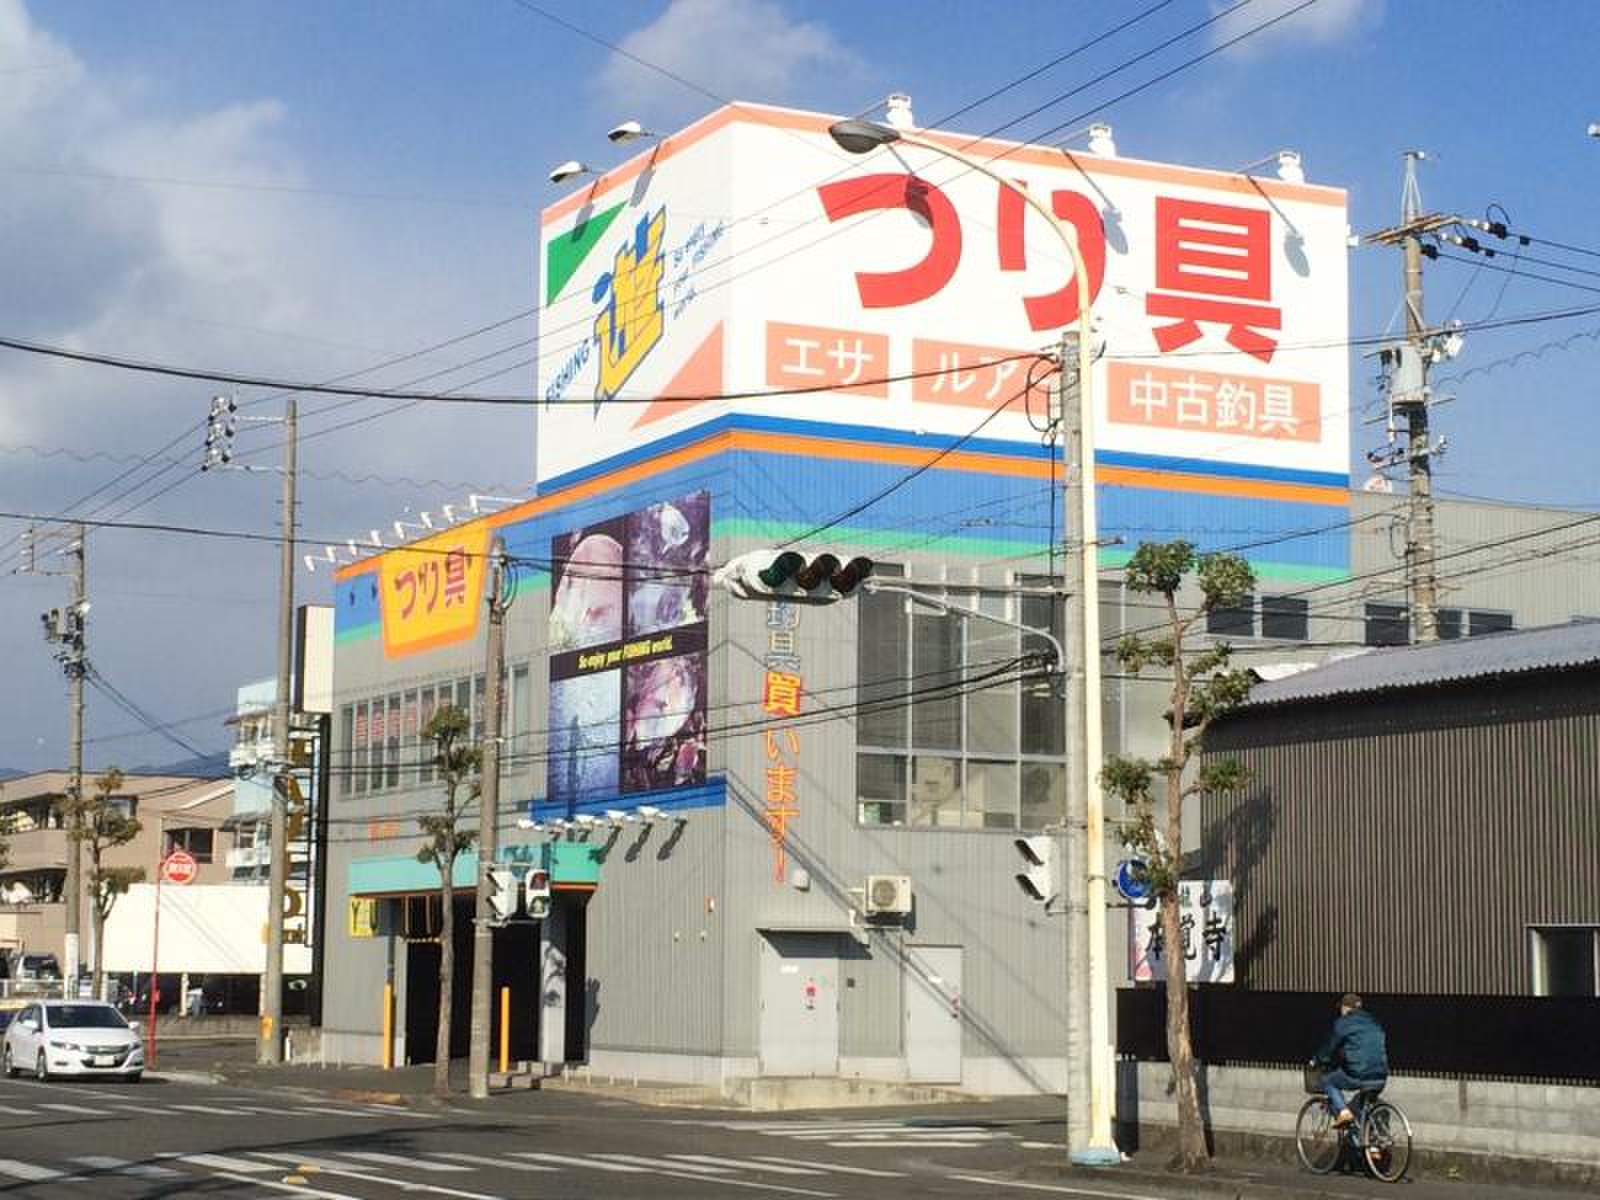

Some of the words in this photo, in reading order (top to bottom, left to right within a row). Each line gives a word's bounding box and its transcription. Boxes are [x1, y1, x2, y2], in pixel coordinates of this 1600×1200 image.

[817, 172, 1283, 363] つり具
[781, 336, 875, 386] エサ
[1129, 377, 1297, 436] 中古釣具
[394, 544, 472, 620] つり具
